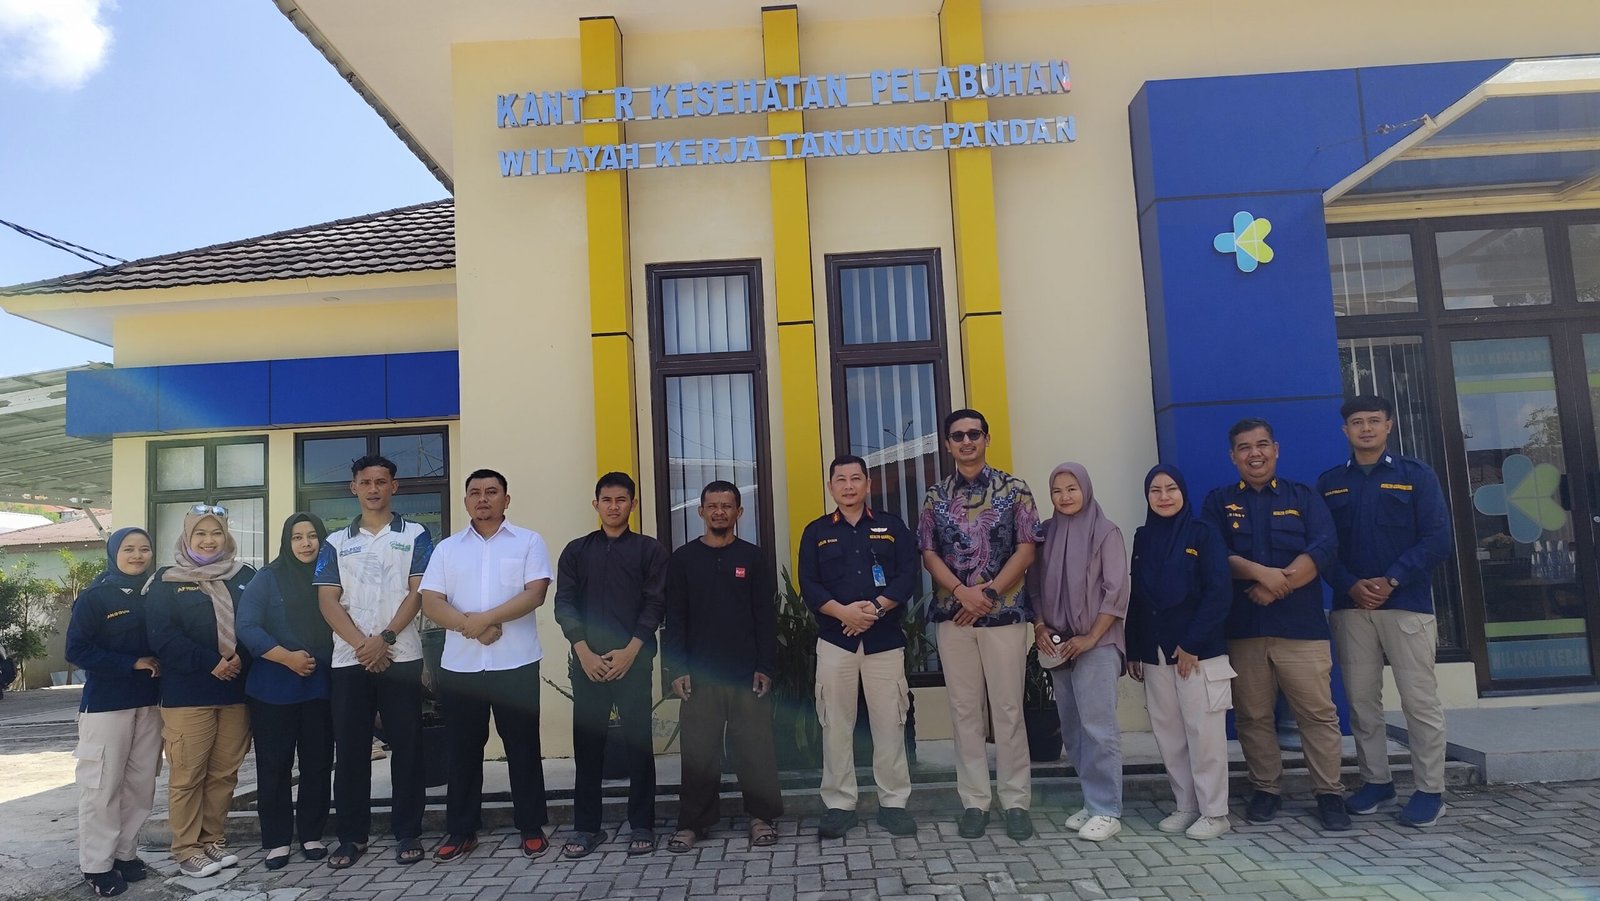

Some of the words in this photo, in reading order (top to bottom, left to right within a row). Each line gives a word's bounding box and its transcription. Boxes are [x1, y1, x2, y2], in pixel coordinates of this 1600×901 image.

[649, 73, 848, 119] KESEHATAN
[870, 59, 1071, 104] PELABUHAN
[498, 143, 640, 177] WILAYAH
[655, 136, 762, 166] KERJA
[779, 125, 932, 159] TANJUNG
[942, 115, 1077, 149] PANDAN
